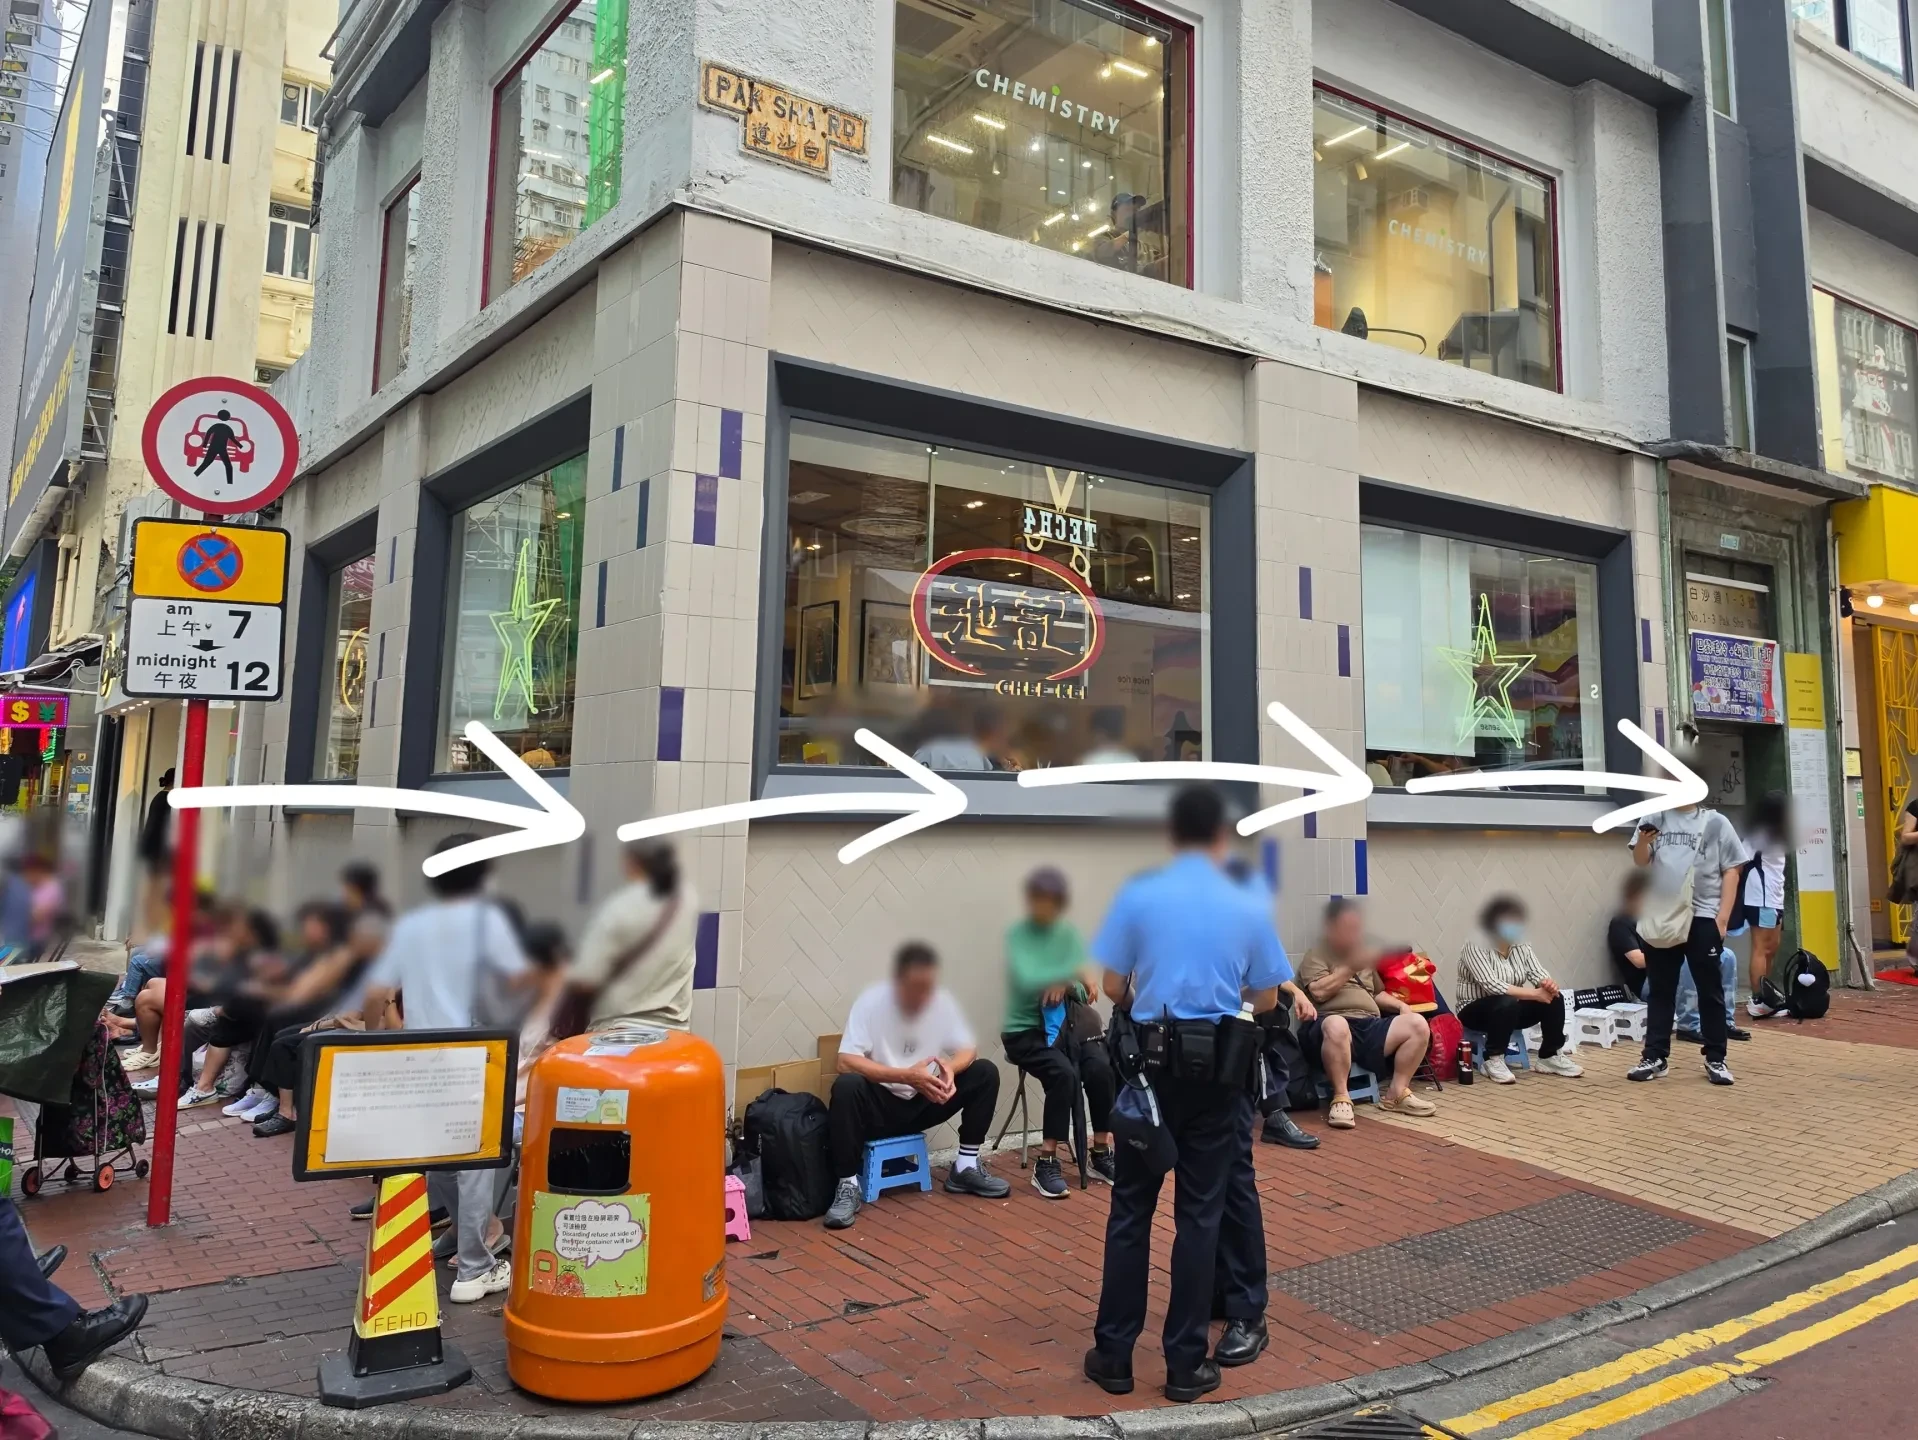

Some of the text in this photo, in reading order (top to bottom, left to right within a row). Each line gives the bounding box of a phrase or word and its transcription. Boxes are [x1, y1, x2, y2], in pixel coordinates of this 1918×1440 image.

[717, 74, 762, 113] PAK
[773, 95, 816, 130] SHA
[166, 604, 193, 615] am
[157, 620, 201, 637] 上午
[228, 610, 252, 639] 7
[136, 653, 217, 670] midnight
[154, 672, 198, 690] 午夜
[227, 661, 270, 691] 12
[995, 680, 1048, 697] CHEE
[374, 1311, 428, 1333] FEHD
